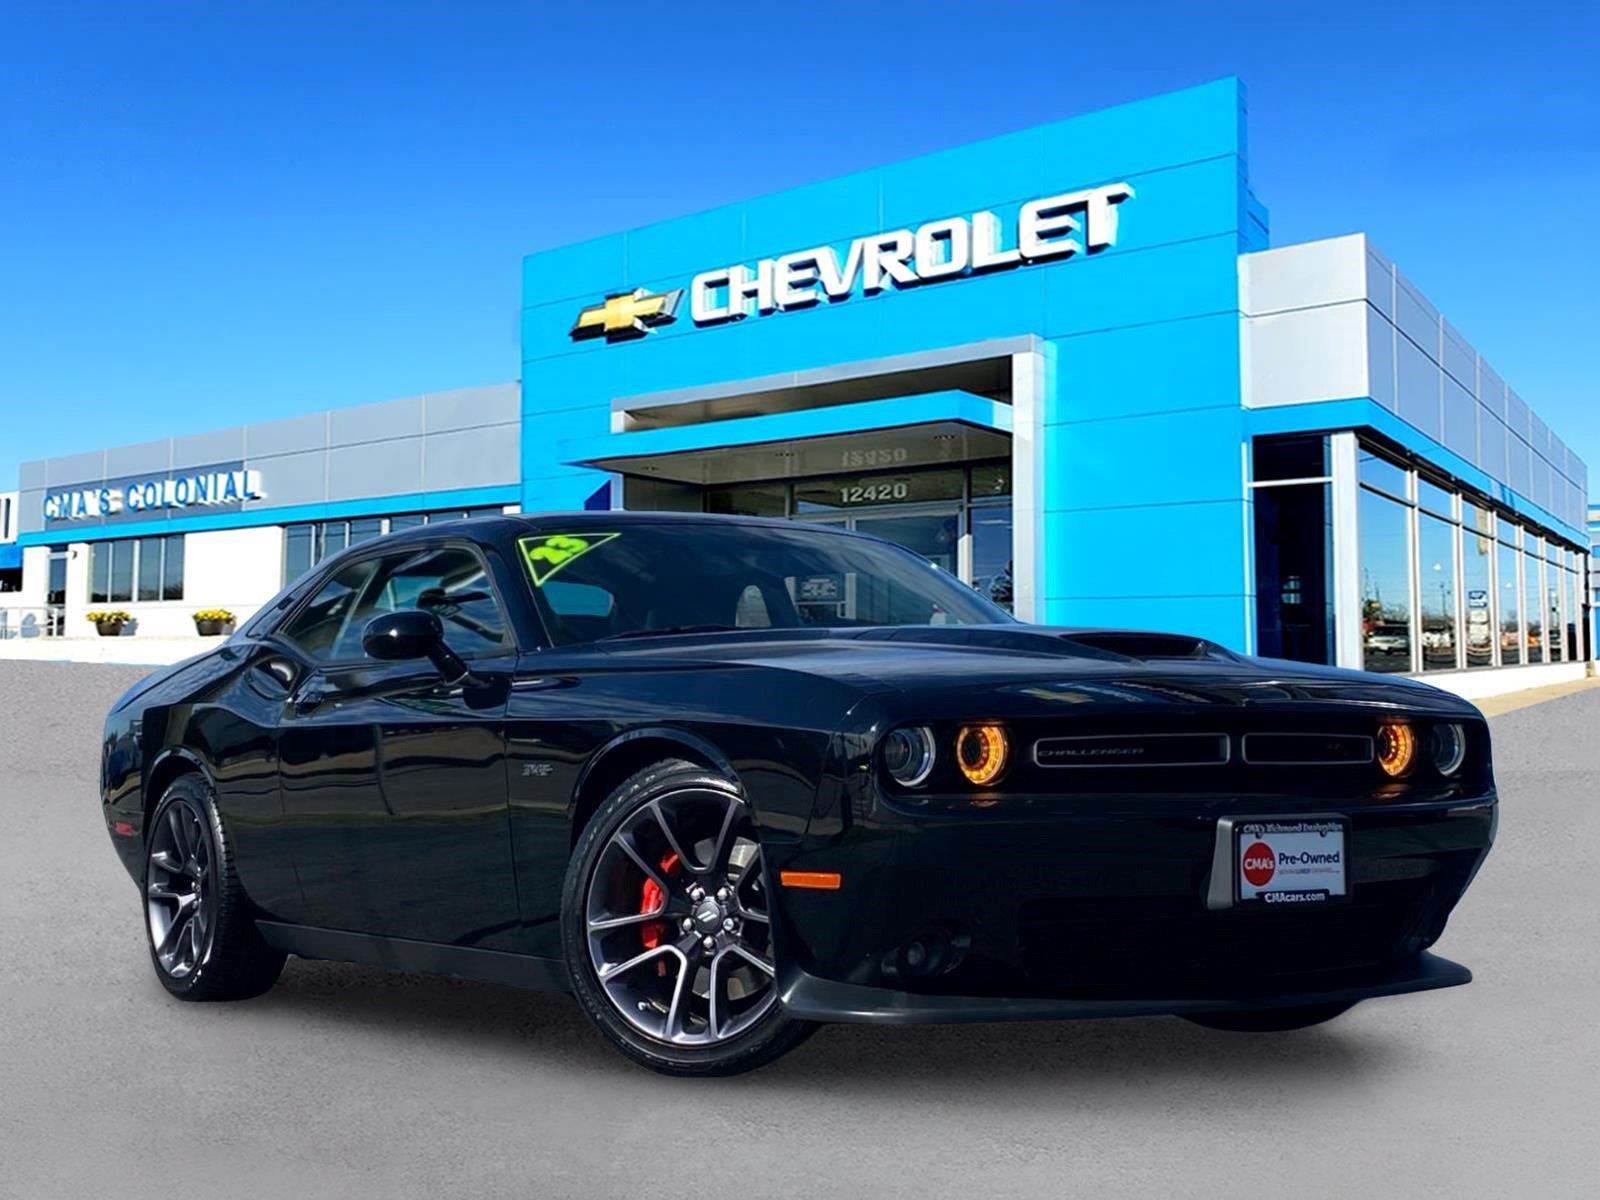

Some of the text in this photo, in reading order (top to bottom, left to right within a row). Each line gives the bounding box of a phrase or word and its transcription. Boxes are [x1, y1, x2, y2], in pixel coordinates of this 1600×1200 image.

[691, 182, 1134, 327] CHEVROLET
[43, 471, 263, 520] CMA'S COLONIAL
[841, 483, 907, 503] 12420
[1037, 746, 1145, 757] CHALLENGER
[1244, 858, 1274, 870] CMA's
[1278, 851, 1340, 865] Pre-Owned
[1264, 892, 1325, 903] CMAcars.com
